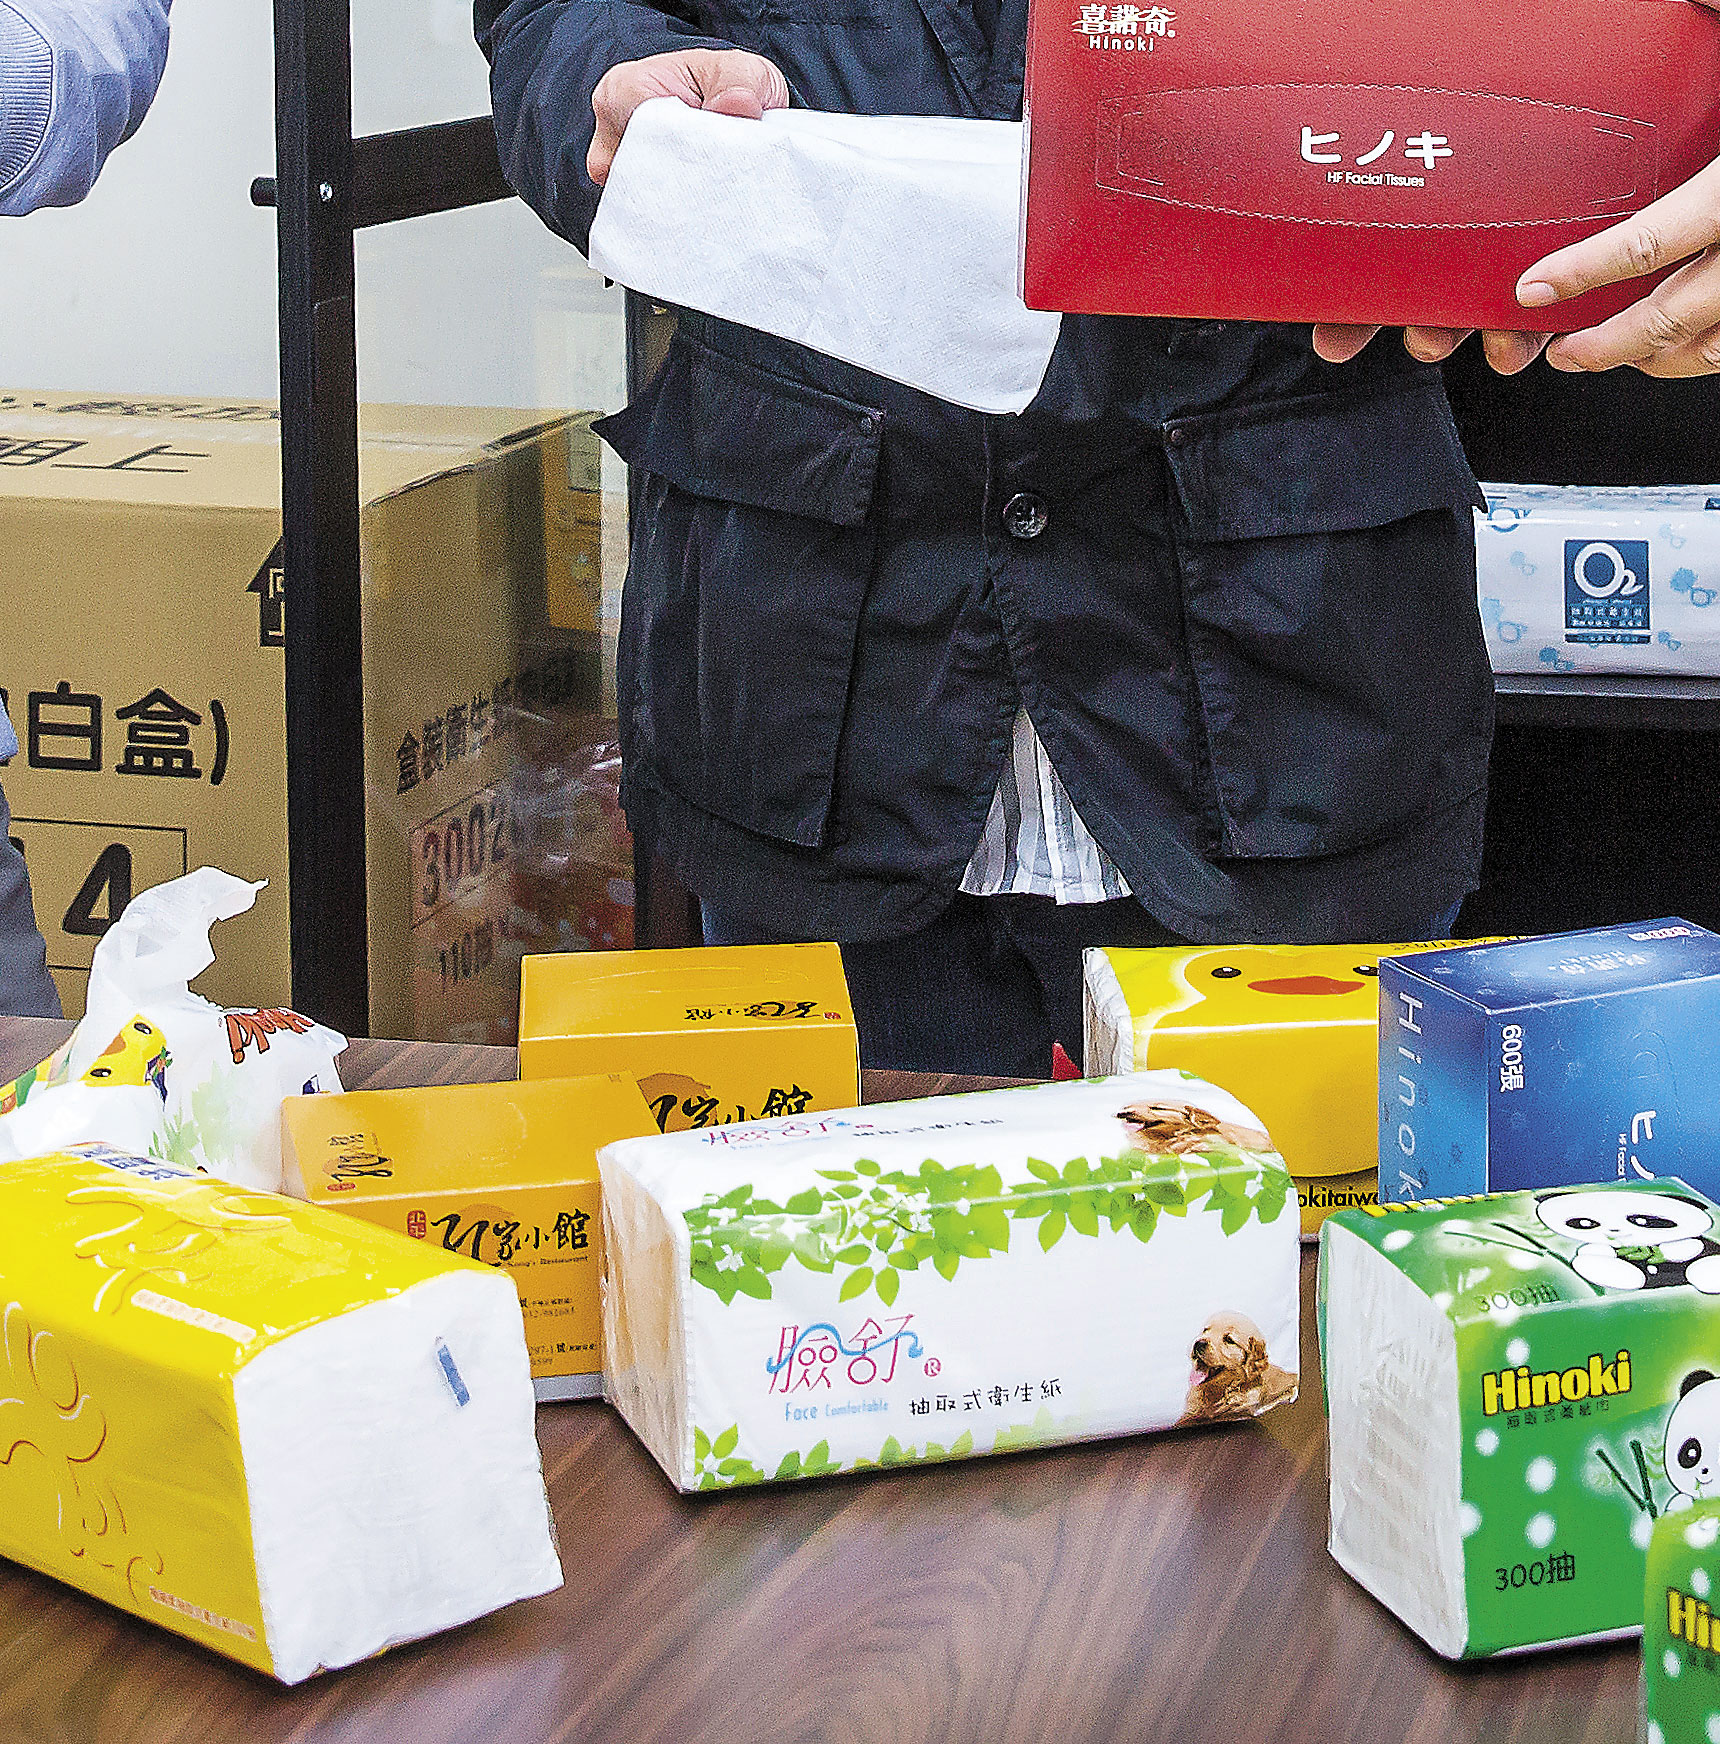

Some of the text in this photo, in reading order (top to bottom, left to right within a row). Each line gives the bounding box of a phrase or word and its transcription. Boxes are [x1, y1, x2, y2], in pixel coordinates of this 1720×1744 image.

[1074, 3, 1170, 38] 喜諾奇
[1088, 35, 1155, 52] Hinoki
[1300, 125, 1454, 170] ヒノキ
[1327, 171, 1425, 187] HF Facial Tissues
[27, 681, 230, 786] 白盒)
[63, 842, 133, 934] 4
[1500, 1024, 1524, 1092] 600張
[1630, 1109, 1657, 1179] ヒノ
[766, 1312, 922, 1394] 臉舒
[908, 1378, 1062, 1416] 抽取式衛生紙
[1482, 1350, 1632, 1416] Hinoki
[785, 1398, 889, 1421] Face Comfortable
[1495, 1552, 1576, 1591] 300抽
